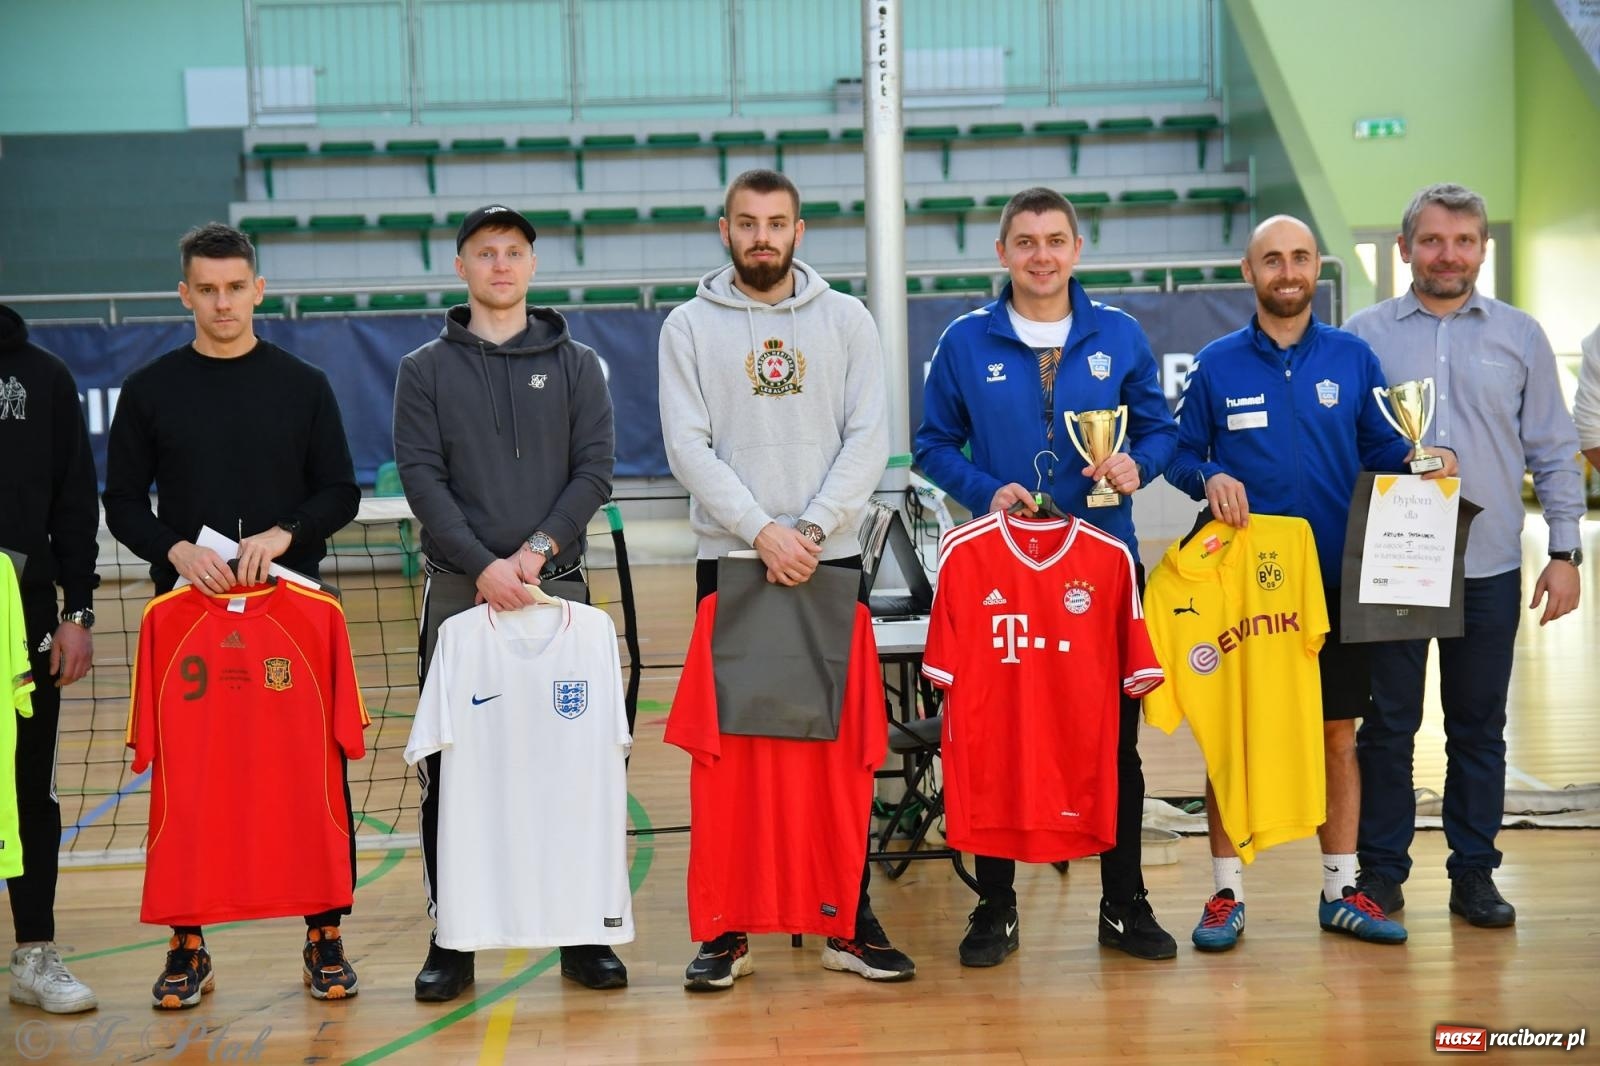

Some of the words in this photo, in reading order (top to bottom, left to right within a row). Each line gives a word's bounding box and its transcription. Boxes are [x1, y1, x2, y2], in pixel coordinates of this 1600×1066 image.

[1226, 393, 1265, 408] hummel
[1393, 495, 1432, 508] Dyplom
[1259, 565, 1282, 583] BVB
[181, 655, 208, 701] 9
